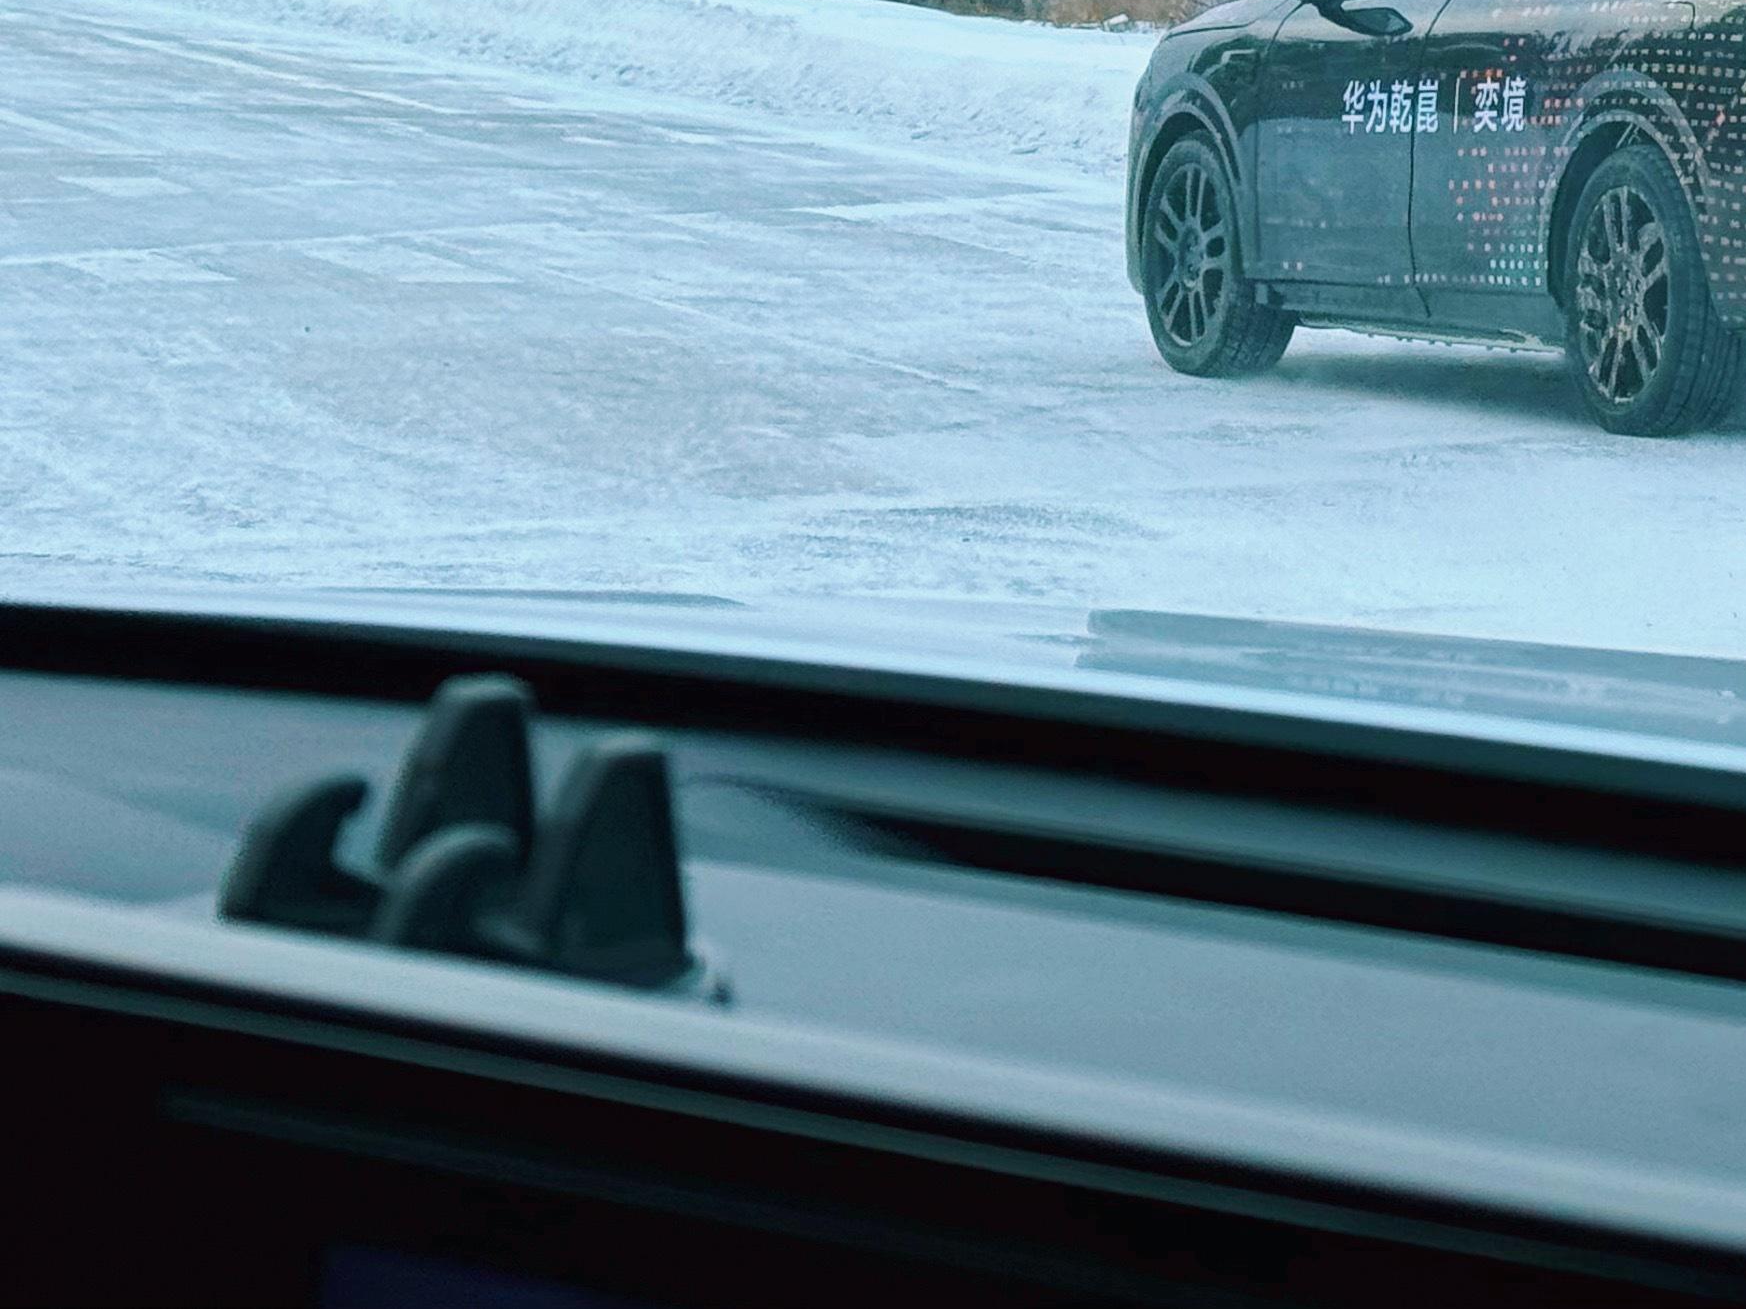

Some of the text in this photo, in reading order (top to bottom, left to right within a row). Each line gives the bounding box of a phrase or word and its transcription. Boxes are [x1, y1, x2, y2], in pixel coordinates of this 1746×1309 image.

[1341, 75, 1528, 134] 华为乾崑 奕境
